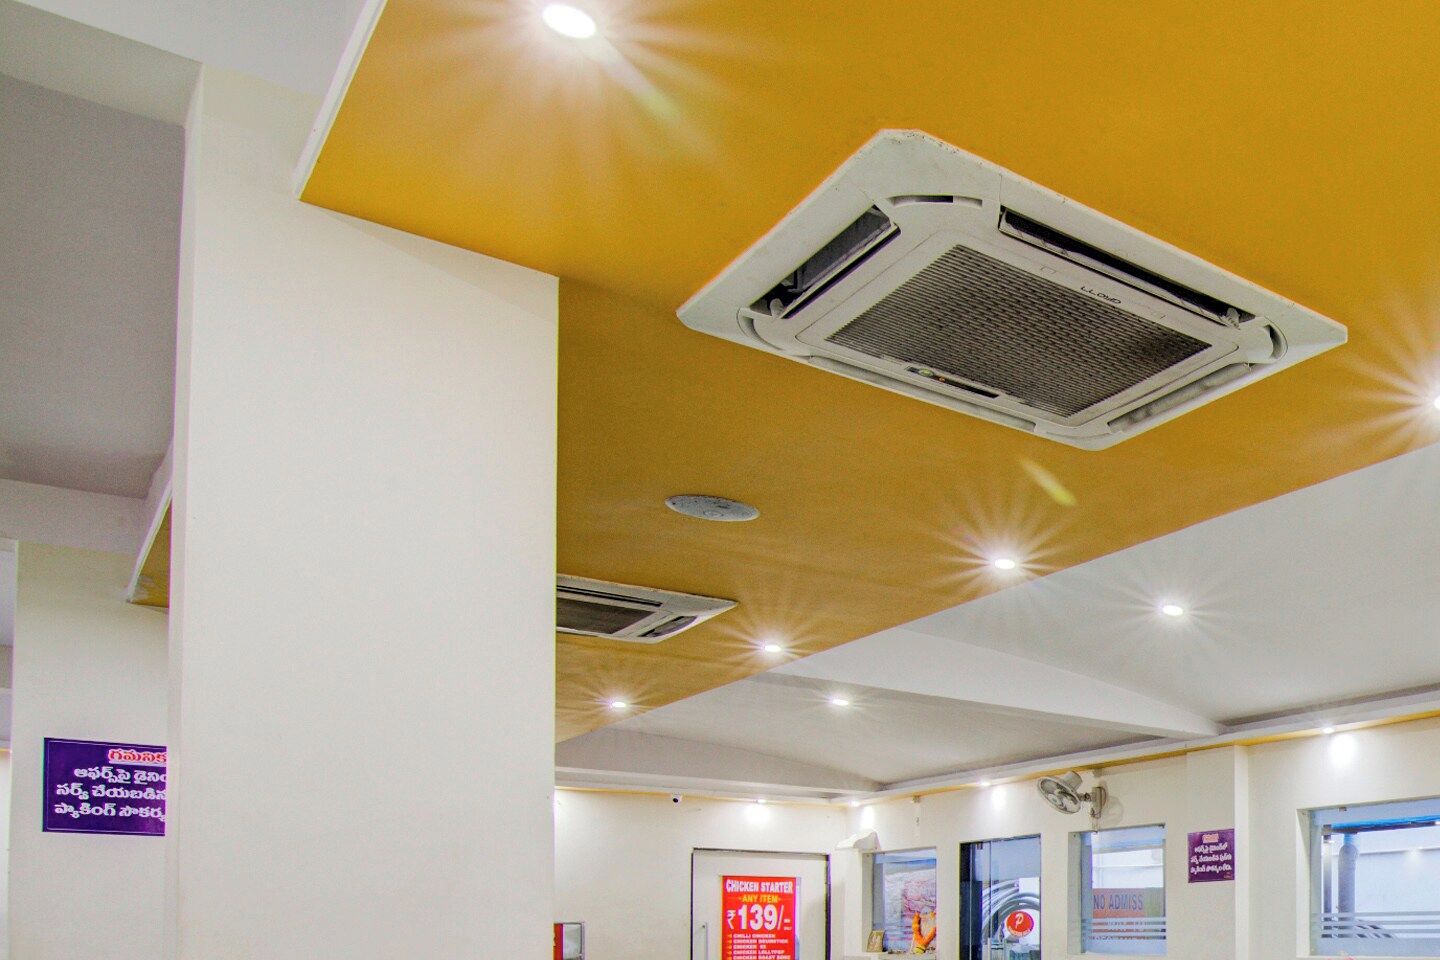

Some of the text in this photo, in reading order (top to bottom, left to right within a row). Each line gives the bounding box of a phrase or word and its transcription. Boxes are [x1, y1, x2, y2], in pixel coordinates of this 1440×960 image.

[1081, 286, 1121, 304] LLOYD
[726, 879, 793, 894] CHICKEN STARTER
[742, 894, 779, 903] ANY ITEM
[1093, 894, 1105, 910] NO
